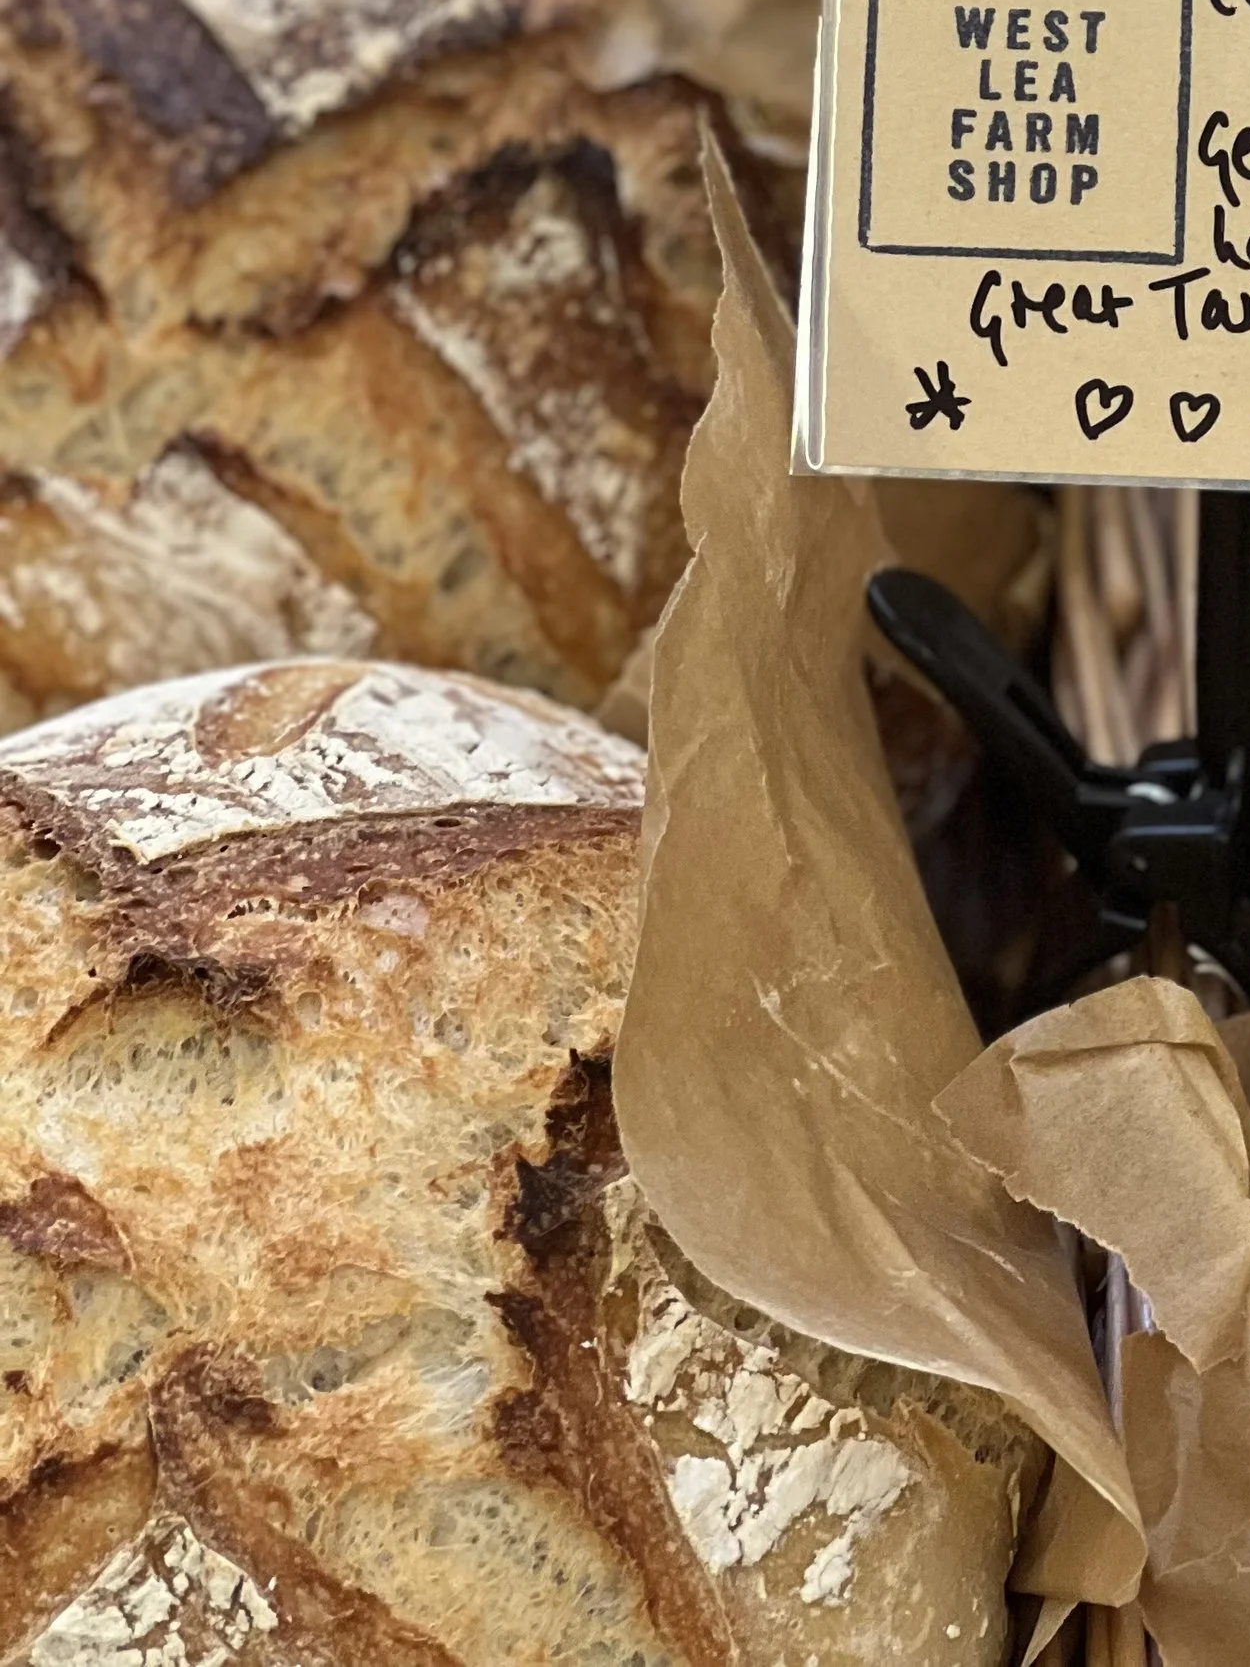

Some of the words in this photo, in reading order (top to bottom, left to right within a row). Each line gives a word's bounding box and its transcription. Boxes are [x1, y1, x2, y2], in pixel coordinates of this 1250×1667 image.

[955, 7, 1106, 54] WEST
[980, 60, 1077, 103] LEA
[951, 110, 1101, 156] FARM
[947, 160, 1099, 206] SHOP
[971, 269, 1133, 366] Great
